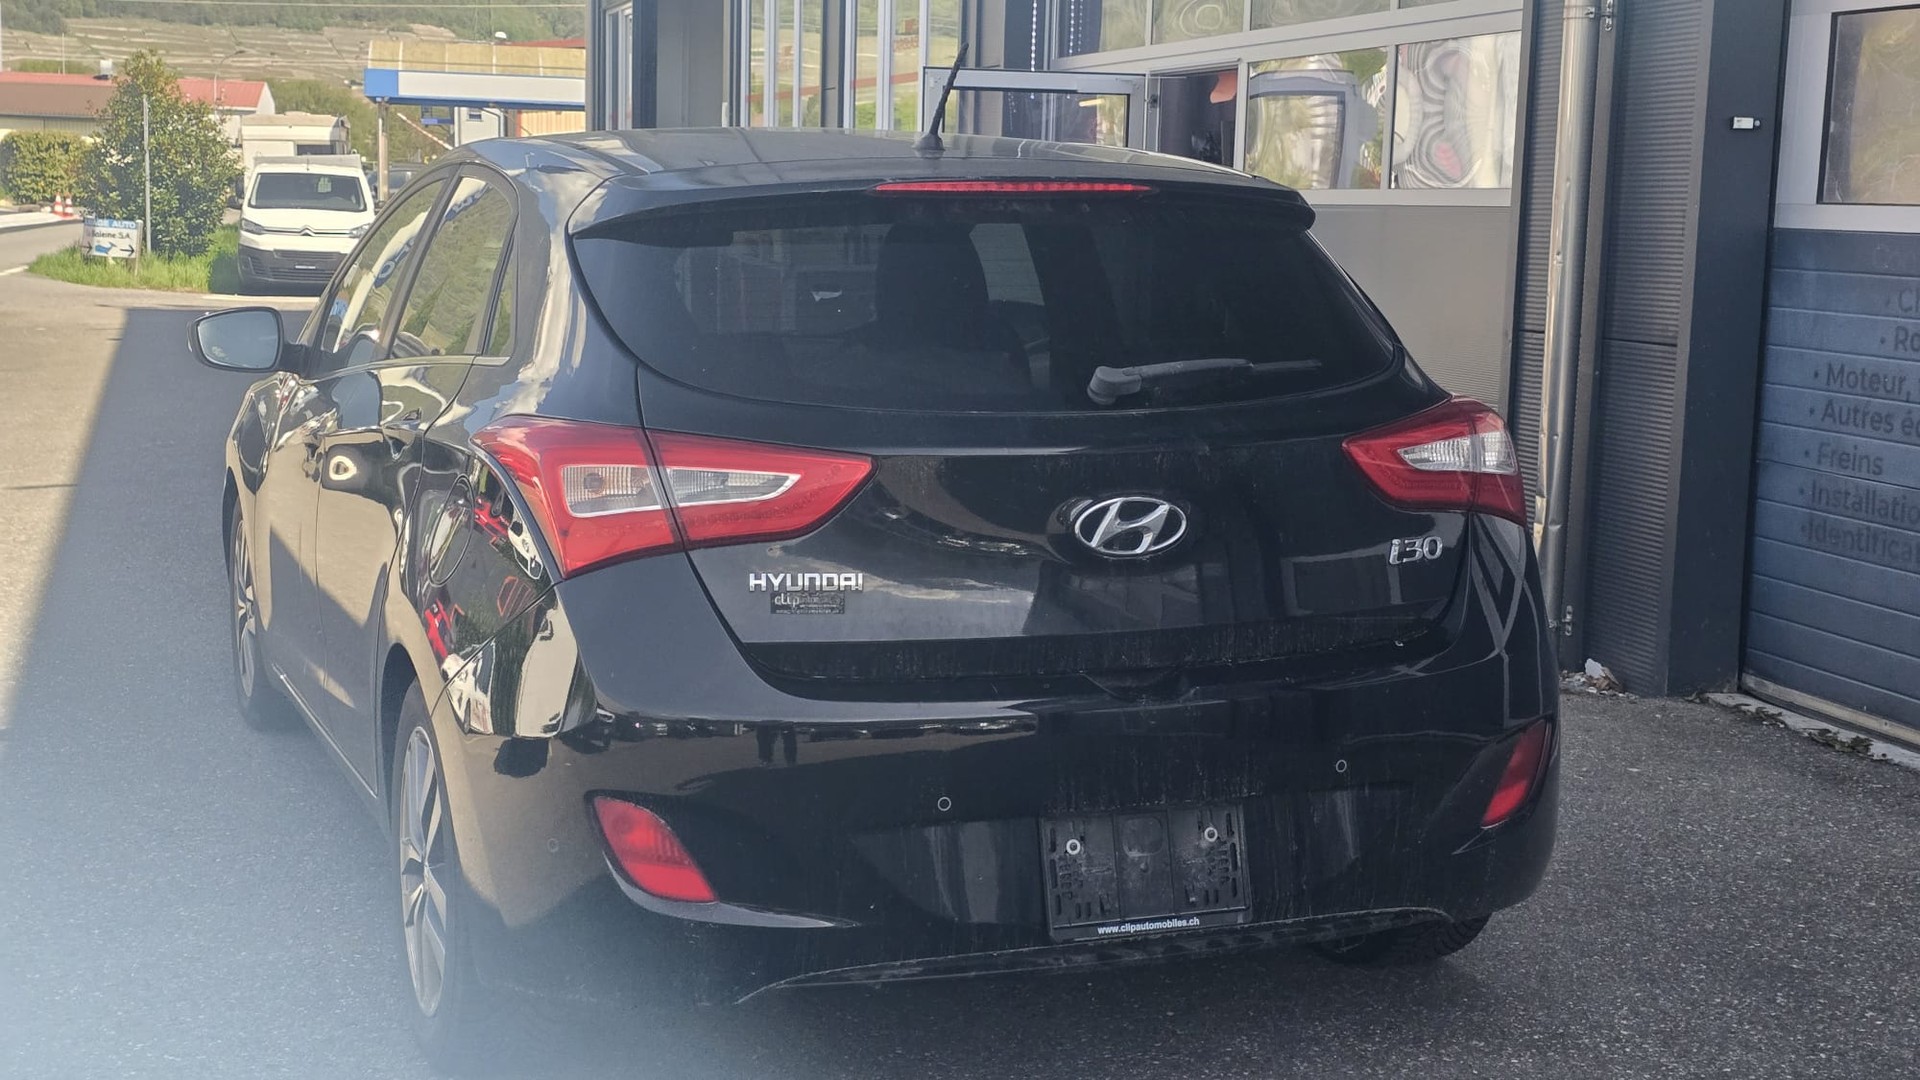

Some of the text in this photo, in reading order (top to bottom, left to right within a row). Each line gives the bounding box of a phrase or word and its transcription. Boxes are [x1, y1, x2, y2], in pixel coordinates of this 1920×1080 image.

[112, 219, 136, 229] AUTO
[1826, 362, 1911, 402] Moteur,
[1821, 399, 1895, 434] Autres
[1817, 442, 1883, 476] Freins
[1389, 536, 1443, 565] i30
[749, 573, 863, 592] HYUNDAI
[1097, 917, 1200, 934] www.clipautomobiles.ch
